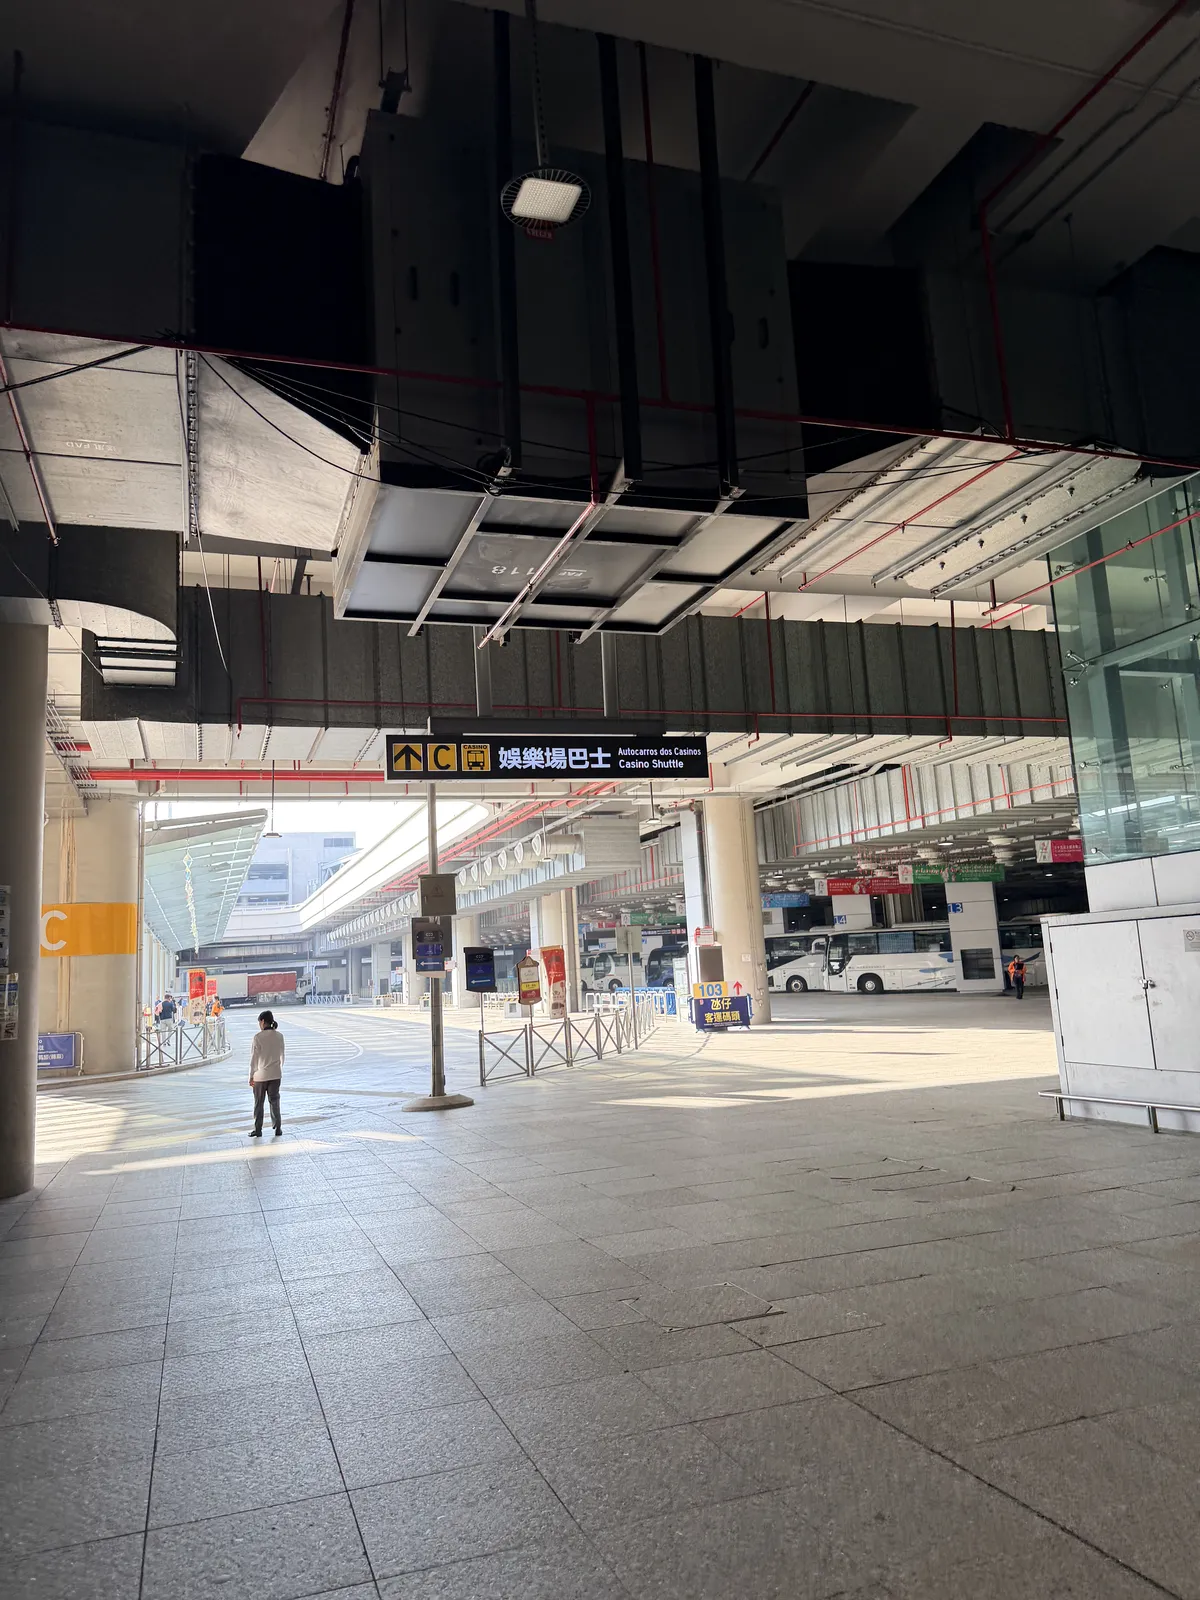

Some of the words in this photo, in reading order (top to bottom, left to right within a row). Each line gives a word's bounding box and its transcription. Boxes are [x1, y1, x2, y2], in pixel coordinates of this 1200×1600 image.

[433, 744, 451, 770] C
[618, 747, 658, 756] Autocarros
[659, 747, 673, 756] dos
[674, 747, 702, 756] Casinos
[498, 746, 612, 770] 娛樂場巴士
[618, 759, 650, 769] Casino
[652, 759, 684, 769] Shuttle
[948, 903, 963, 913] 13
[835, 915, 847, 925] 14
[40, 909, 68, 951] C
[699, 984, 722, 996] 103
